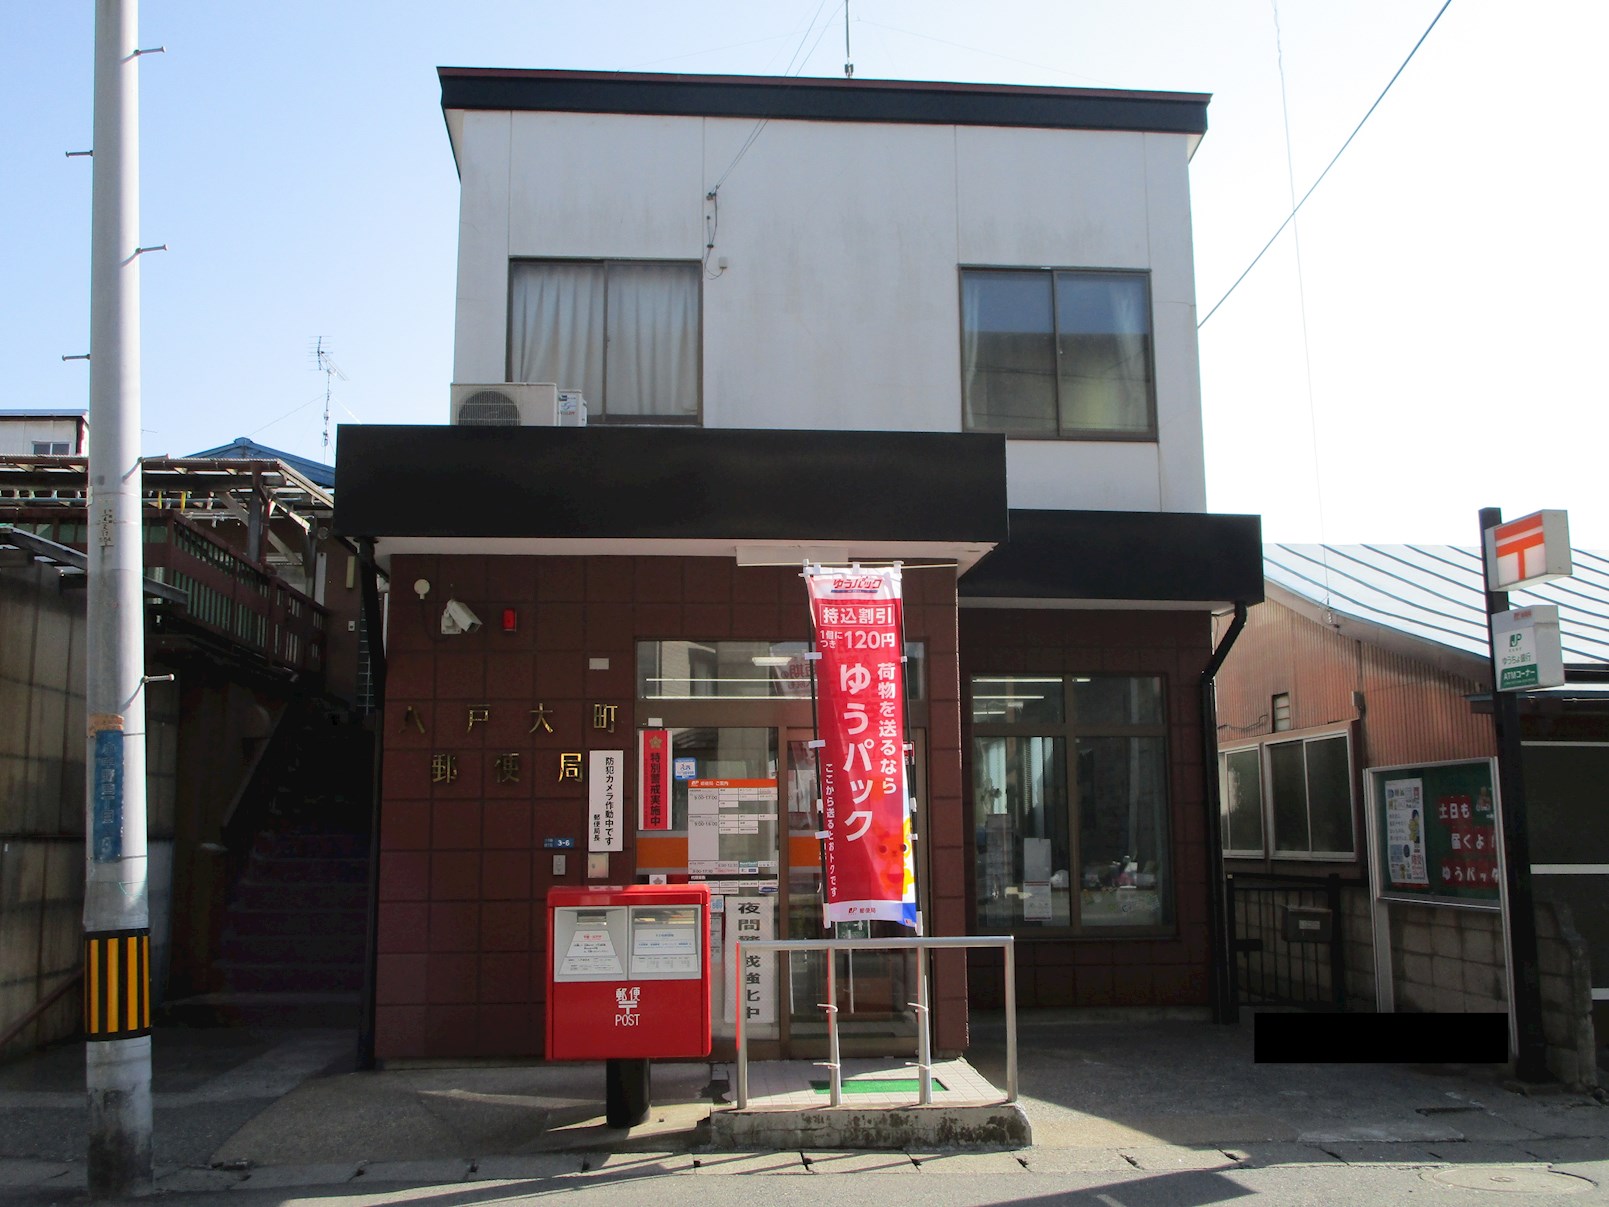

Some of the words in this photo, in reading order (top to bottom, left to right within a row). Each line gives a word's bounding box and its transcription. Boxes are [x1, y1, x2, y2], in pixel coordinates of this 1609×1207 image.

[832, 576, 883, 589] ゆうパック
[823, 606, 892, 625] 持込割引
[820, 640, 836, 649] つき
[844, 631, 895, 650] 120円
[1502, 652, 1531, 665] ゆうちょ銀行
[1503, 668, 1536, 681] ATMコーナー
[399, 702, 618, 734] 八戸大町
[877, 662, 897, 795] 荷物を送るなら
[839, 663, 875, 842] ゆうパック
[431, 752, 583, 783] 郵便局
[650, 752, 662, 826] 特別警戒実施中
[604, 756, 615, 846] 防犯カメラ作動中です
[1439, 802, 1470, 819] 土日も
[557, 839, 571, 847] 3-6
[615, 987, 640, 1001] 郵便
[615, 1014, 640, 1026] POST
